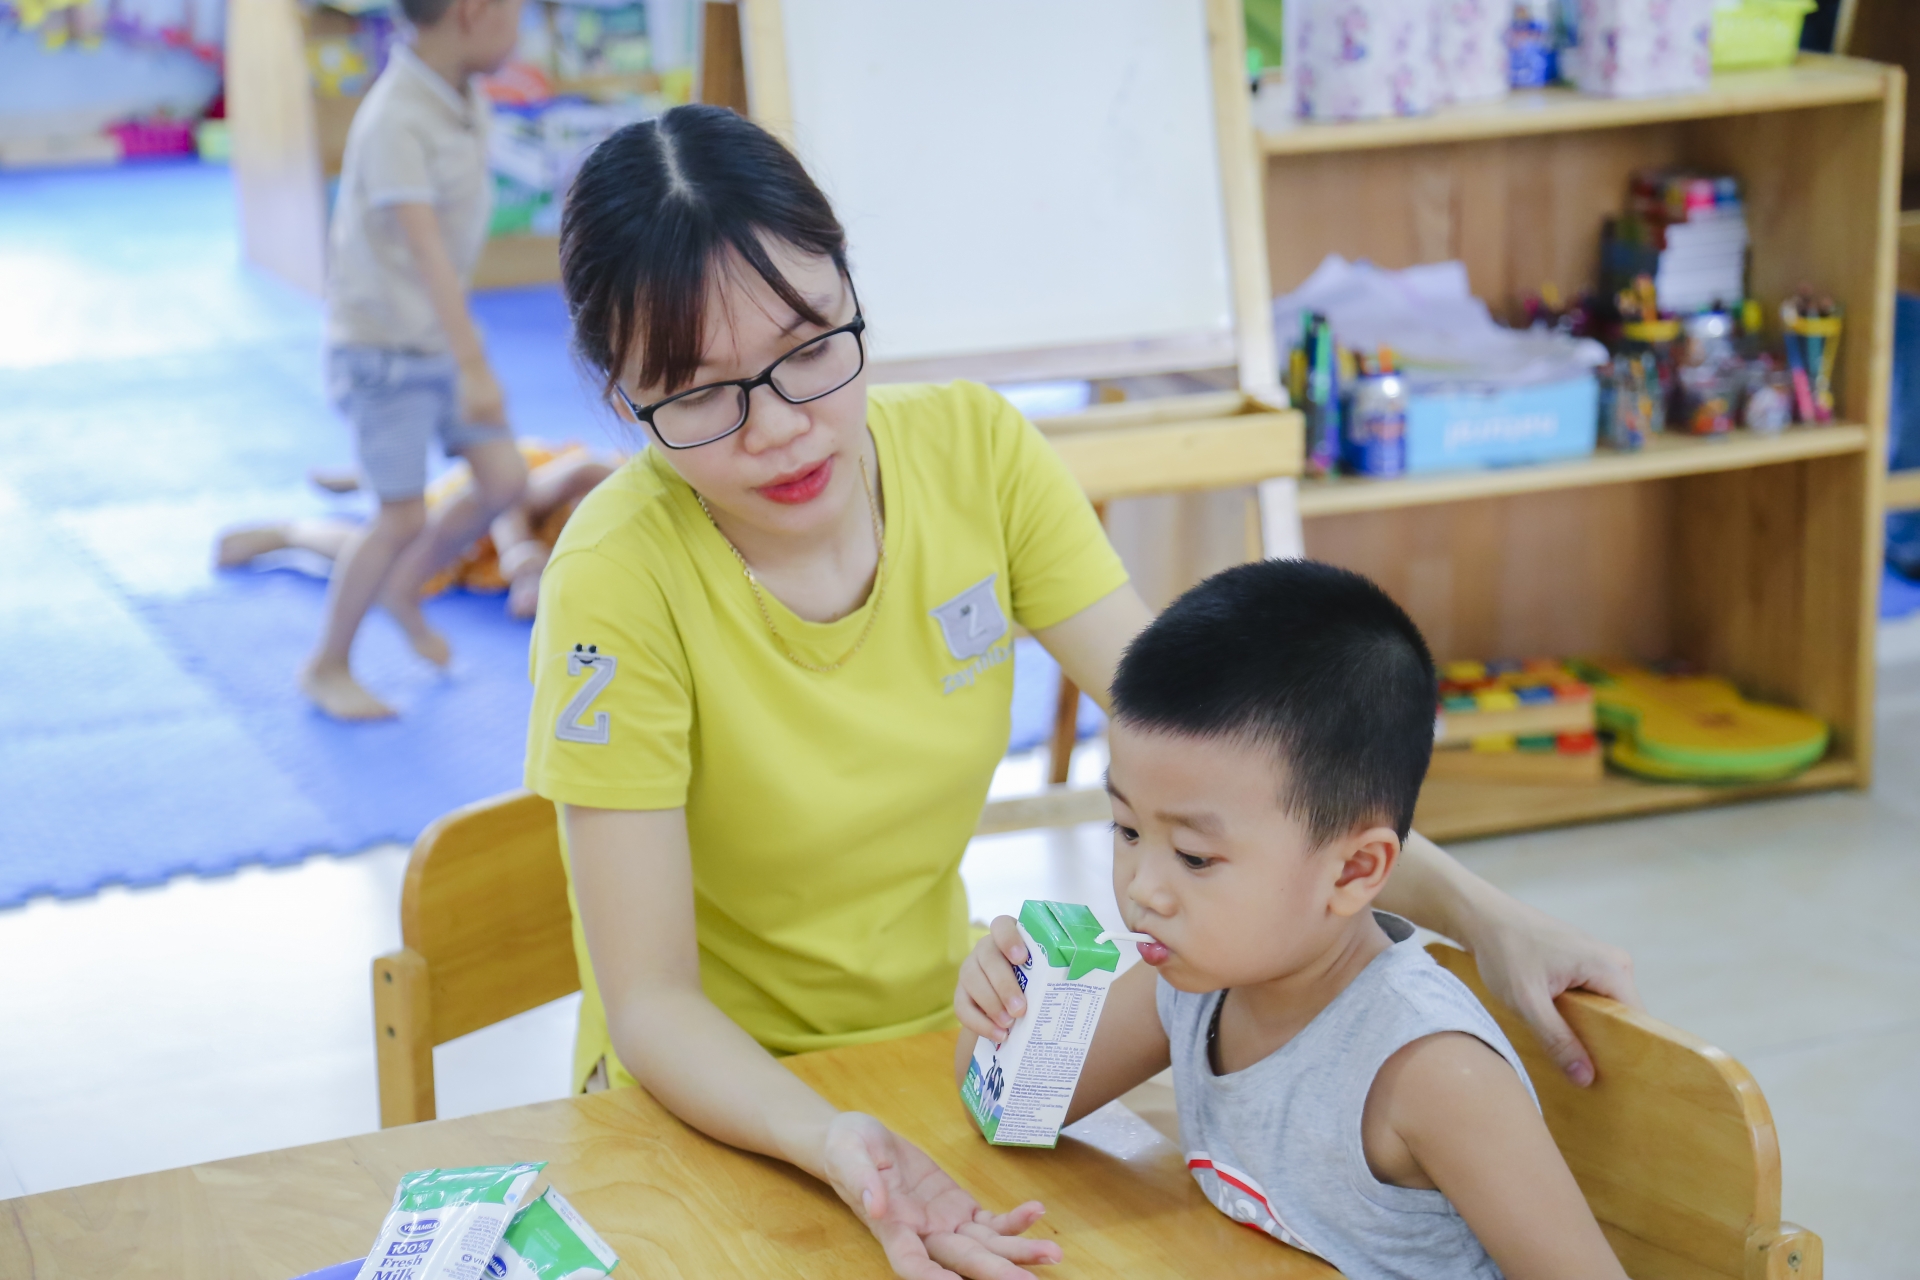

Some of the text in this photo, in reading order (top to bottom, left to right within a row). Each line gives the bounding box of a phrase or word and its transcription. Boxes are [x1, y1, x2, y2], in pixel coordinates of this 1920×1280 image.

[554, 651, 616, 745] Z
[403, 1220, 438, 1232] VINAMILK
[391, 1241, 430, 1255] 100%
[379, 1254, 424, 1268] Fresh
[371, 1268, 416, 1280] Milk
